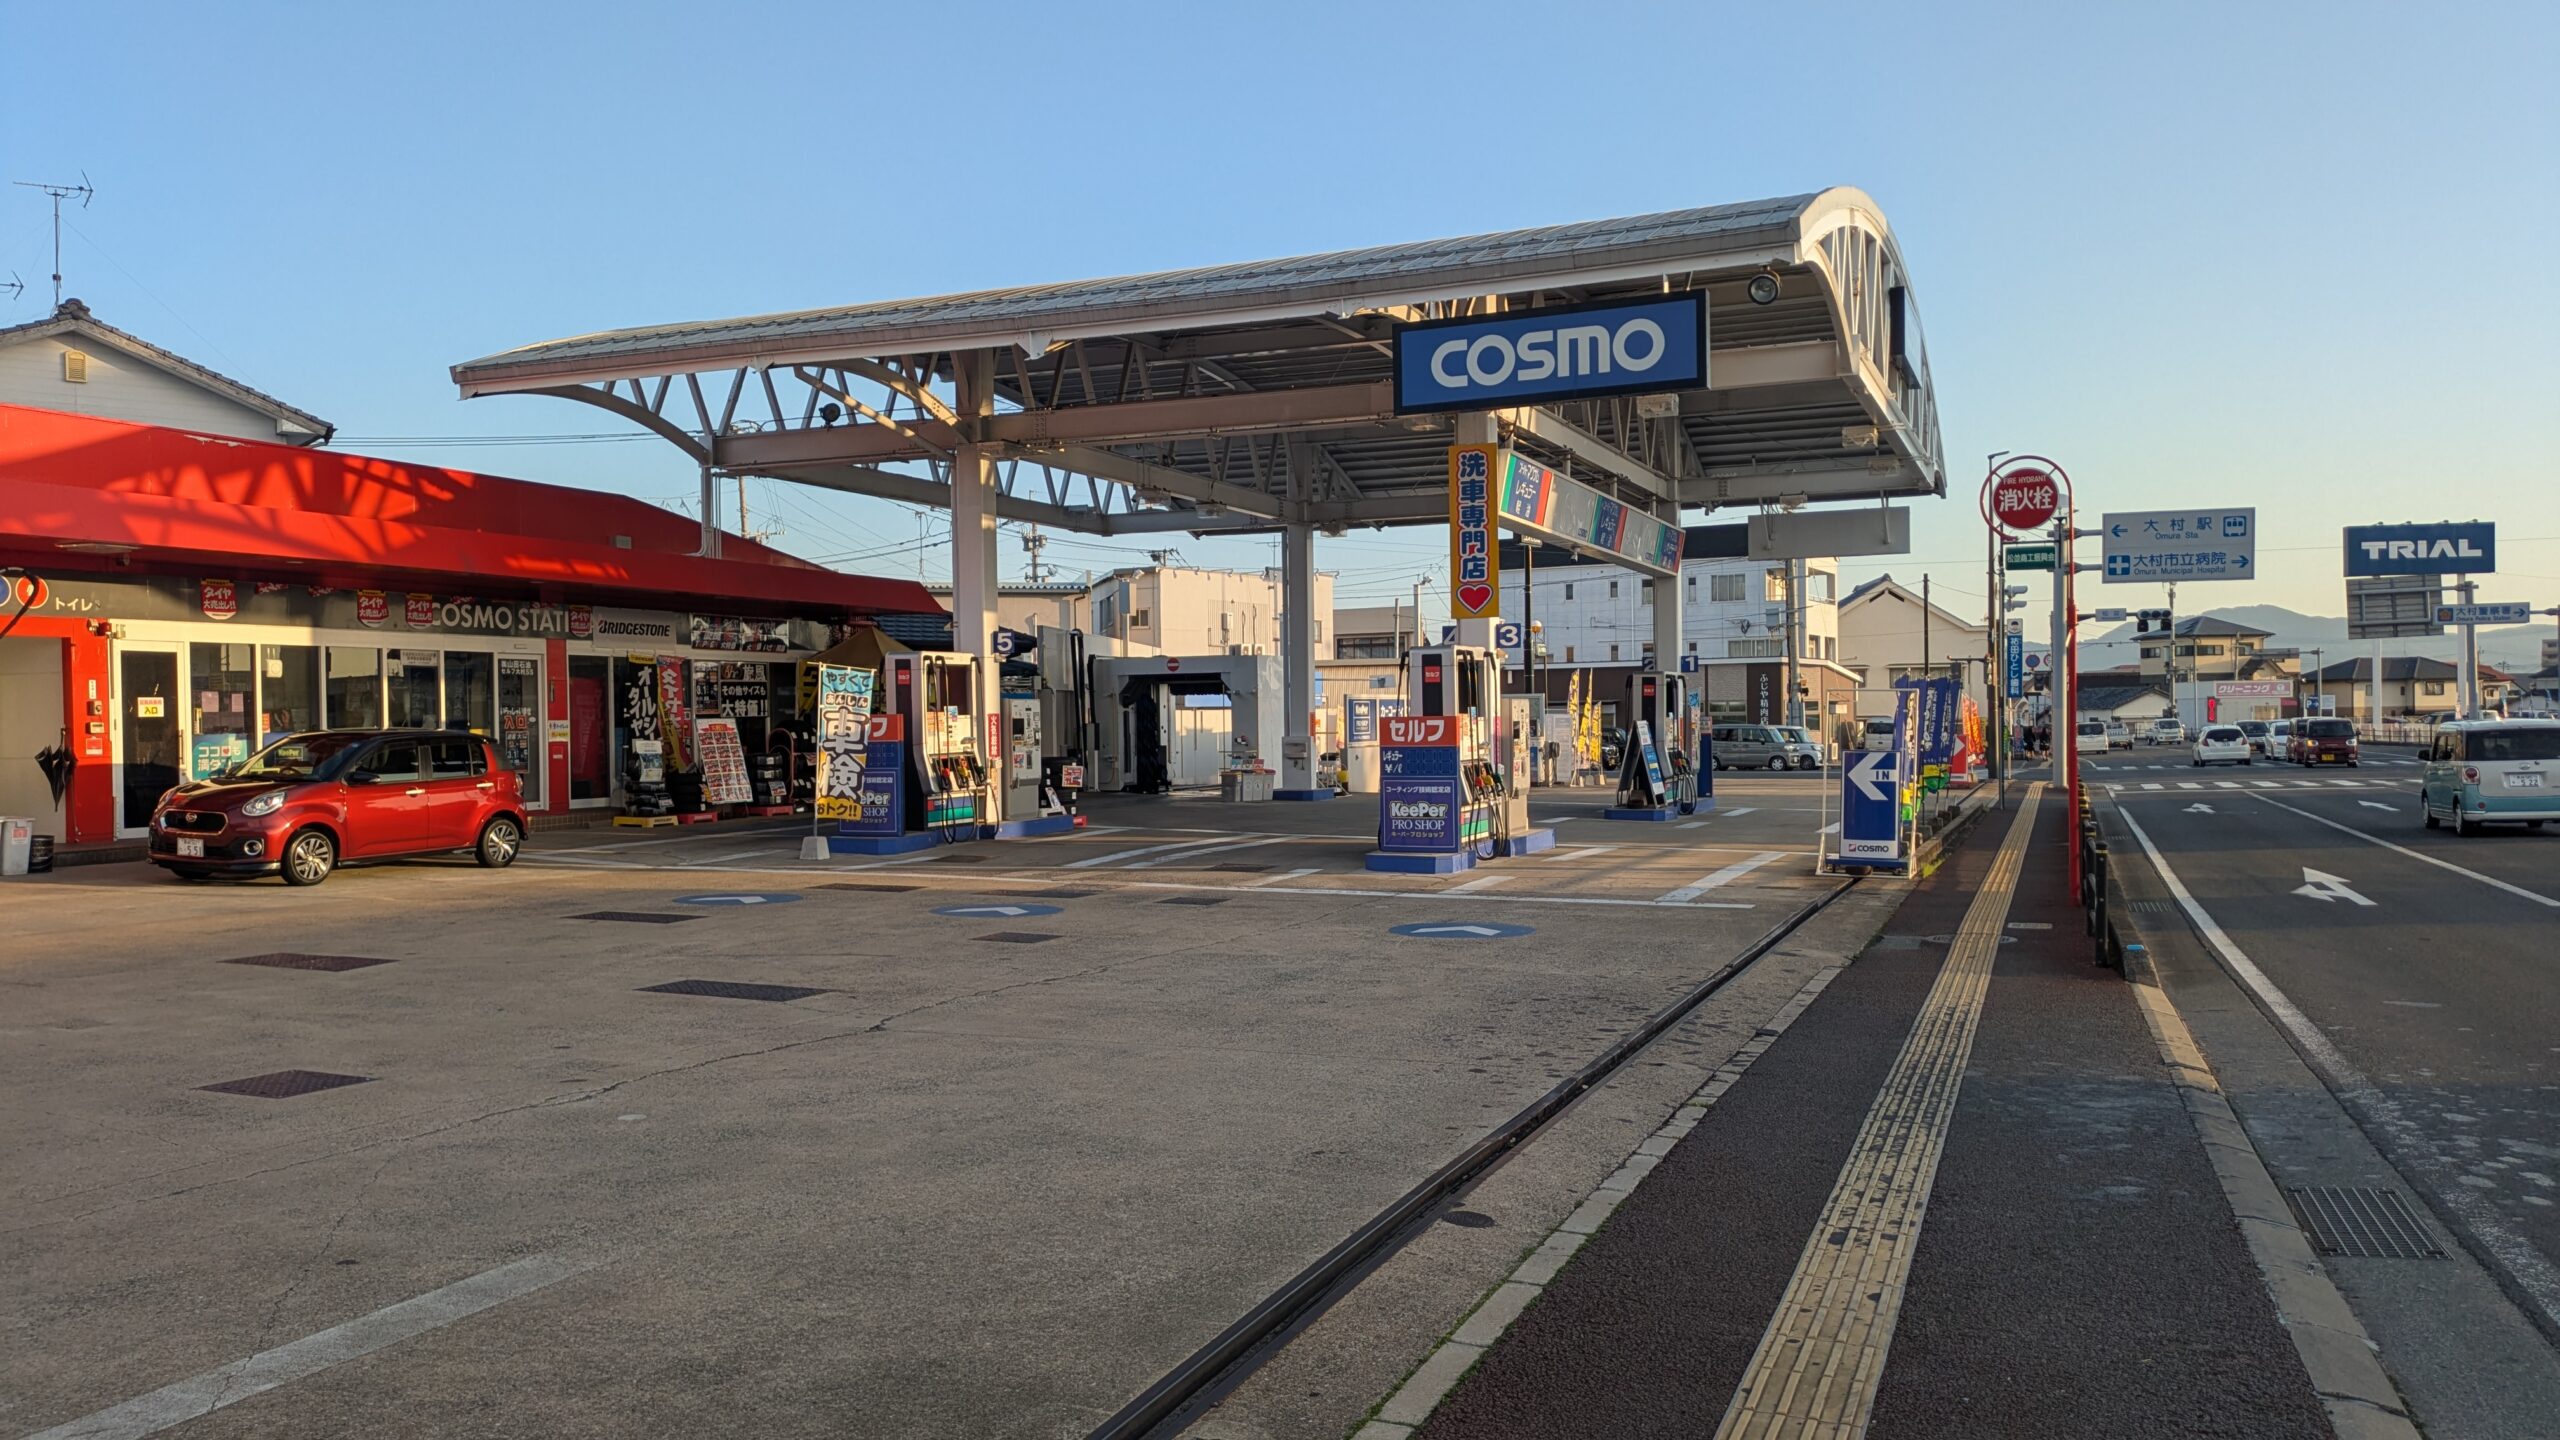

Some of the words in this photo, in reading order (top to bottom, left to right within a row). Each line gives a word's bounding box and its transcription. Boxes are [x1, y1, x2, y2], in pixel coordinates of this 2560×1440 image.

[1431, 318, 1666, 388] COSMO
[2003, 476, 2017, 485] FIRE
[2018, 475, 2047, 484] HYDRANT
[1515, 480, 1537, 500] レギュラー
[1998, 485, 2054, 512] 消火栓
[1459, 452, 1487, 580] 洗車専門店
[2144, 516, 2212, 532] 大村駅
[2156, 532, 2180, 540] Omura
[2360, 538, 2483, 560] TRIAL
[2133, 551, 2227, 568] 大村市立病院
[2134, 566, 2156, 575] Omura
[2160, 566, 2193, 576] Municipal
[2197, 565, 2226, 575] Hospital
[204, 586, 232, 600] タイヤ
[54, 596, 93, 612] トイレ
[358, 596, 384, 609] タイヤ
[408, 600, 430, 612] タイヤ
[431, 602, 513, 630] COSMO
[570, 610, 590, 622] タイヤ
[2456, 606, 2512, 616] 大村警察署
[598, 620, 671, 637] BRIDGESTONE
[1500, 626, 1520, 647] 3
[996, 632, 1013, 652] 5
[742, 663, 766, 681] 旋風
[1684, 656, 1695, 672] 1
[826, 671, 870, 688] やすくて
[721, 686, 767, 697] その他サイズも
[2218, 684, 2271, 694] クリーニング
[826, 694, 868, 708] あんしん
[1760, 672, 1770, 725] ふじや精肉店
[2307, 700, 2312, 708] P
[144, 706, 158, 715] 入口
[628, 686, 644, 737] タイヤ
[721, 700, 768, 718] 大特価!!
[504, 716, 528, 729] 入口
[1389, 720, 1444, 742] セルフ
[823, 706, 868, 800] 車検
[1382, 750, 1403, 762] レギュラー
[1876, 770, 1890, 780] IN
[818, 803, 858, 817] おトク!!
[863, 807, 888, 816] SHOP
[1390, 802, 1447, 818] KeePer
[1392, 820, 1413, 830] PRO
[1415, 820, 1445, 830] SHOP
[1857, 844, 1888, 853] COSMO
